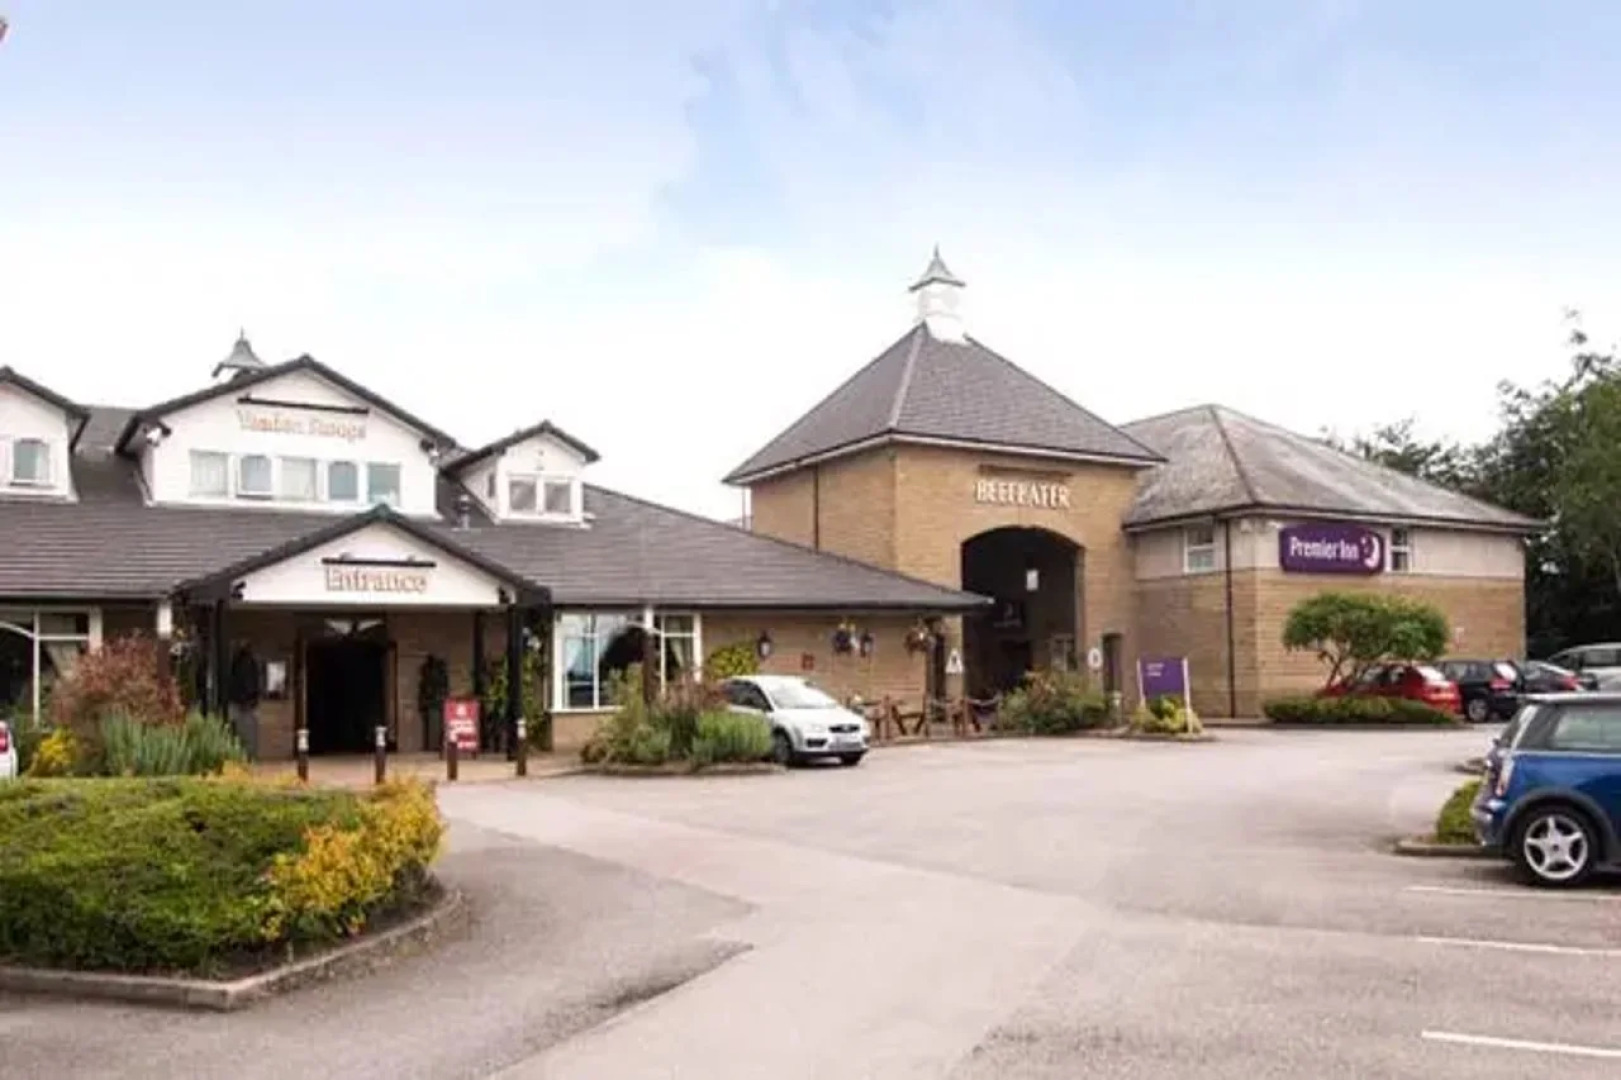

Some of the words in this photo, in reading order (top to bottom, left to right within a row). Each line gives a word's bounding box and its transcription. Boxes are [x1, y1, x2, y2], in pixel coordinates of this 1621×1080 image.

[976, 480, 1071, 508] BEEFEATER
[1290, 536, 1337, 559] Premier
[1340, 539, 1359, 560] Inn
[326, 567, 427, 593] Entrance
